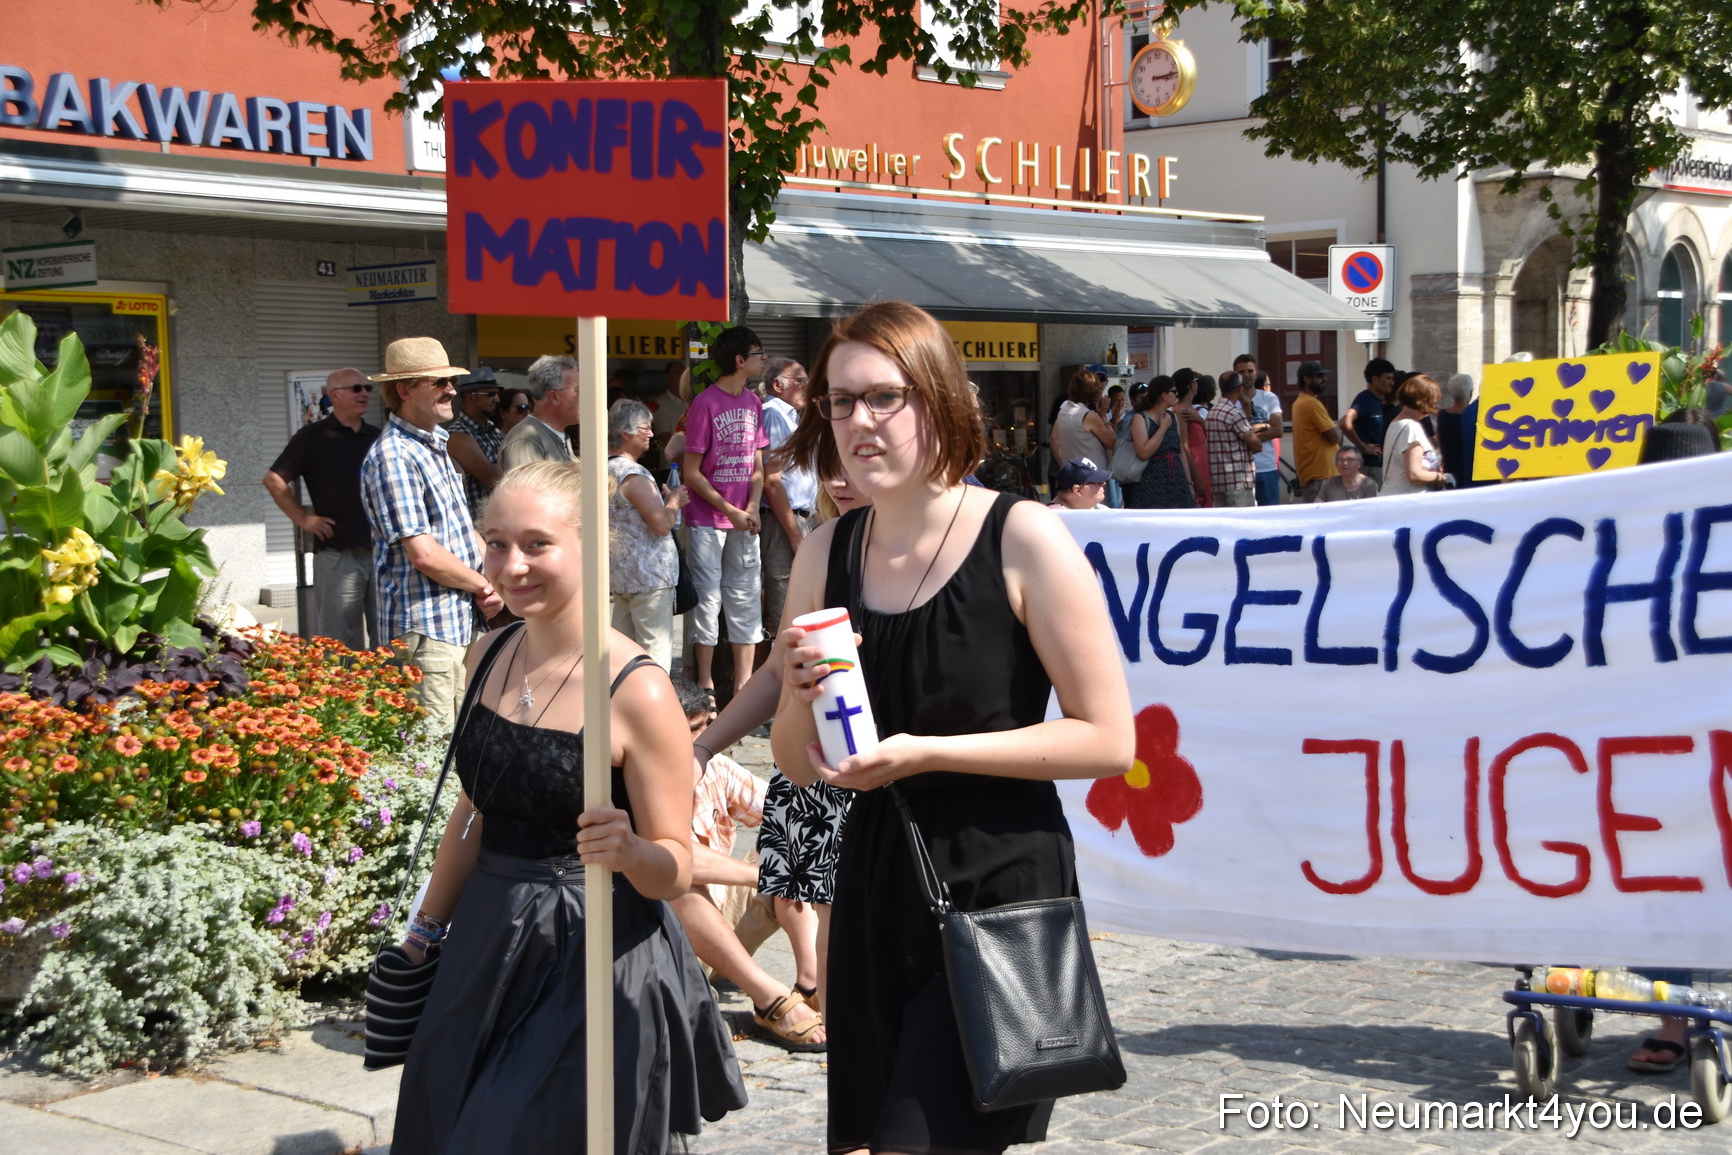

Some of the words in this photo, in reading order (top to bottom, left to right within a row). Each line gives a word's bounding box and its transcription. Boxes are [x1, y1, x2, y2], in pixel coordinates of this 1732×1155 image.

[0, 65, 373, 160] BAKWAREN
[452, 97, 724, 181] KONFIR-
[942, 132, 1179, 199] SCHLIERF
[465, 211, 726, 299] MATION
[7, 258, 36, 280] NZ
[36, 253, 92, 266] NORDBAYERISCHE
[38, 267, 65, 279] ZEITUNG
[318, 262, 334, 275] 41
[355, 268, 428, 288] NEUMARKTER
[369, 288, 415, 300] Nachrichten
[1346, 297, 1378, 308] ZONE
[129, 301, 159, 312] LOTTO
[953, 340, 1038, 358] CHLIERF
